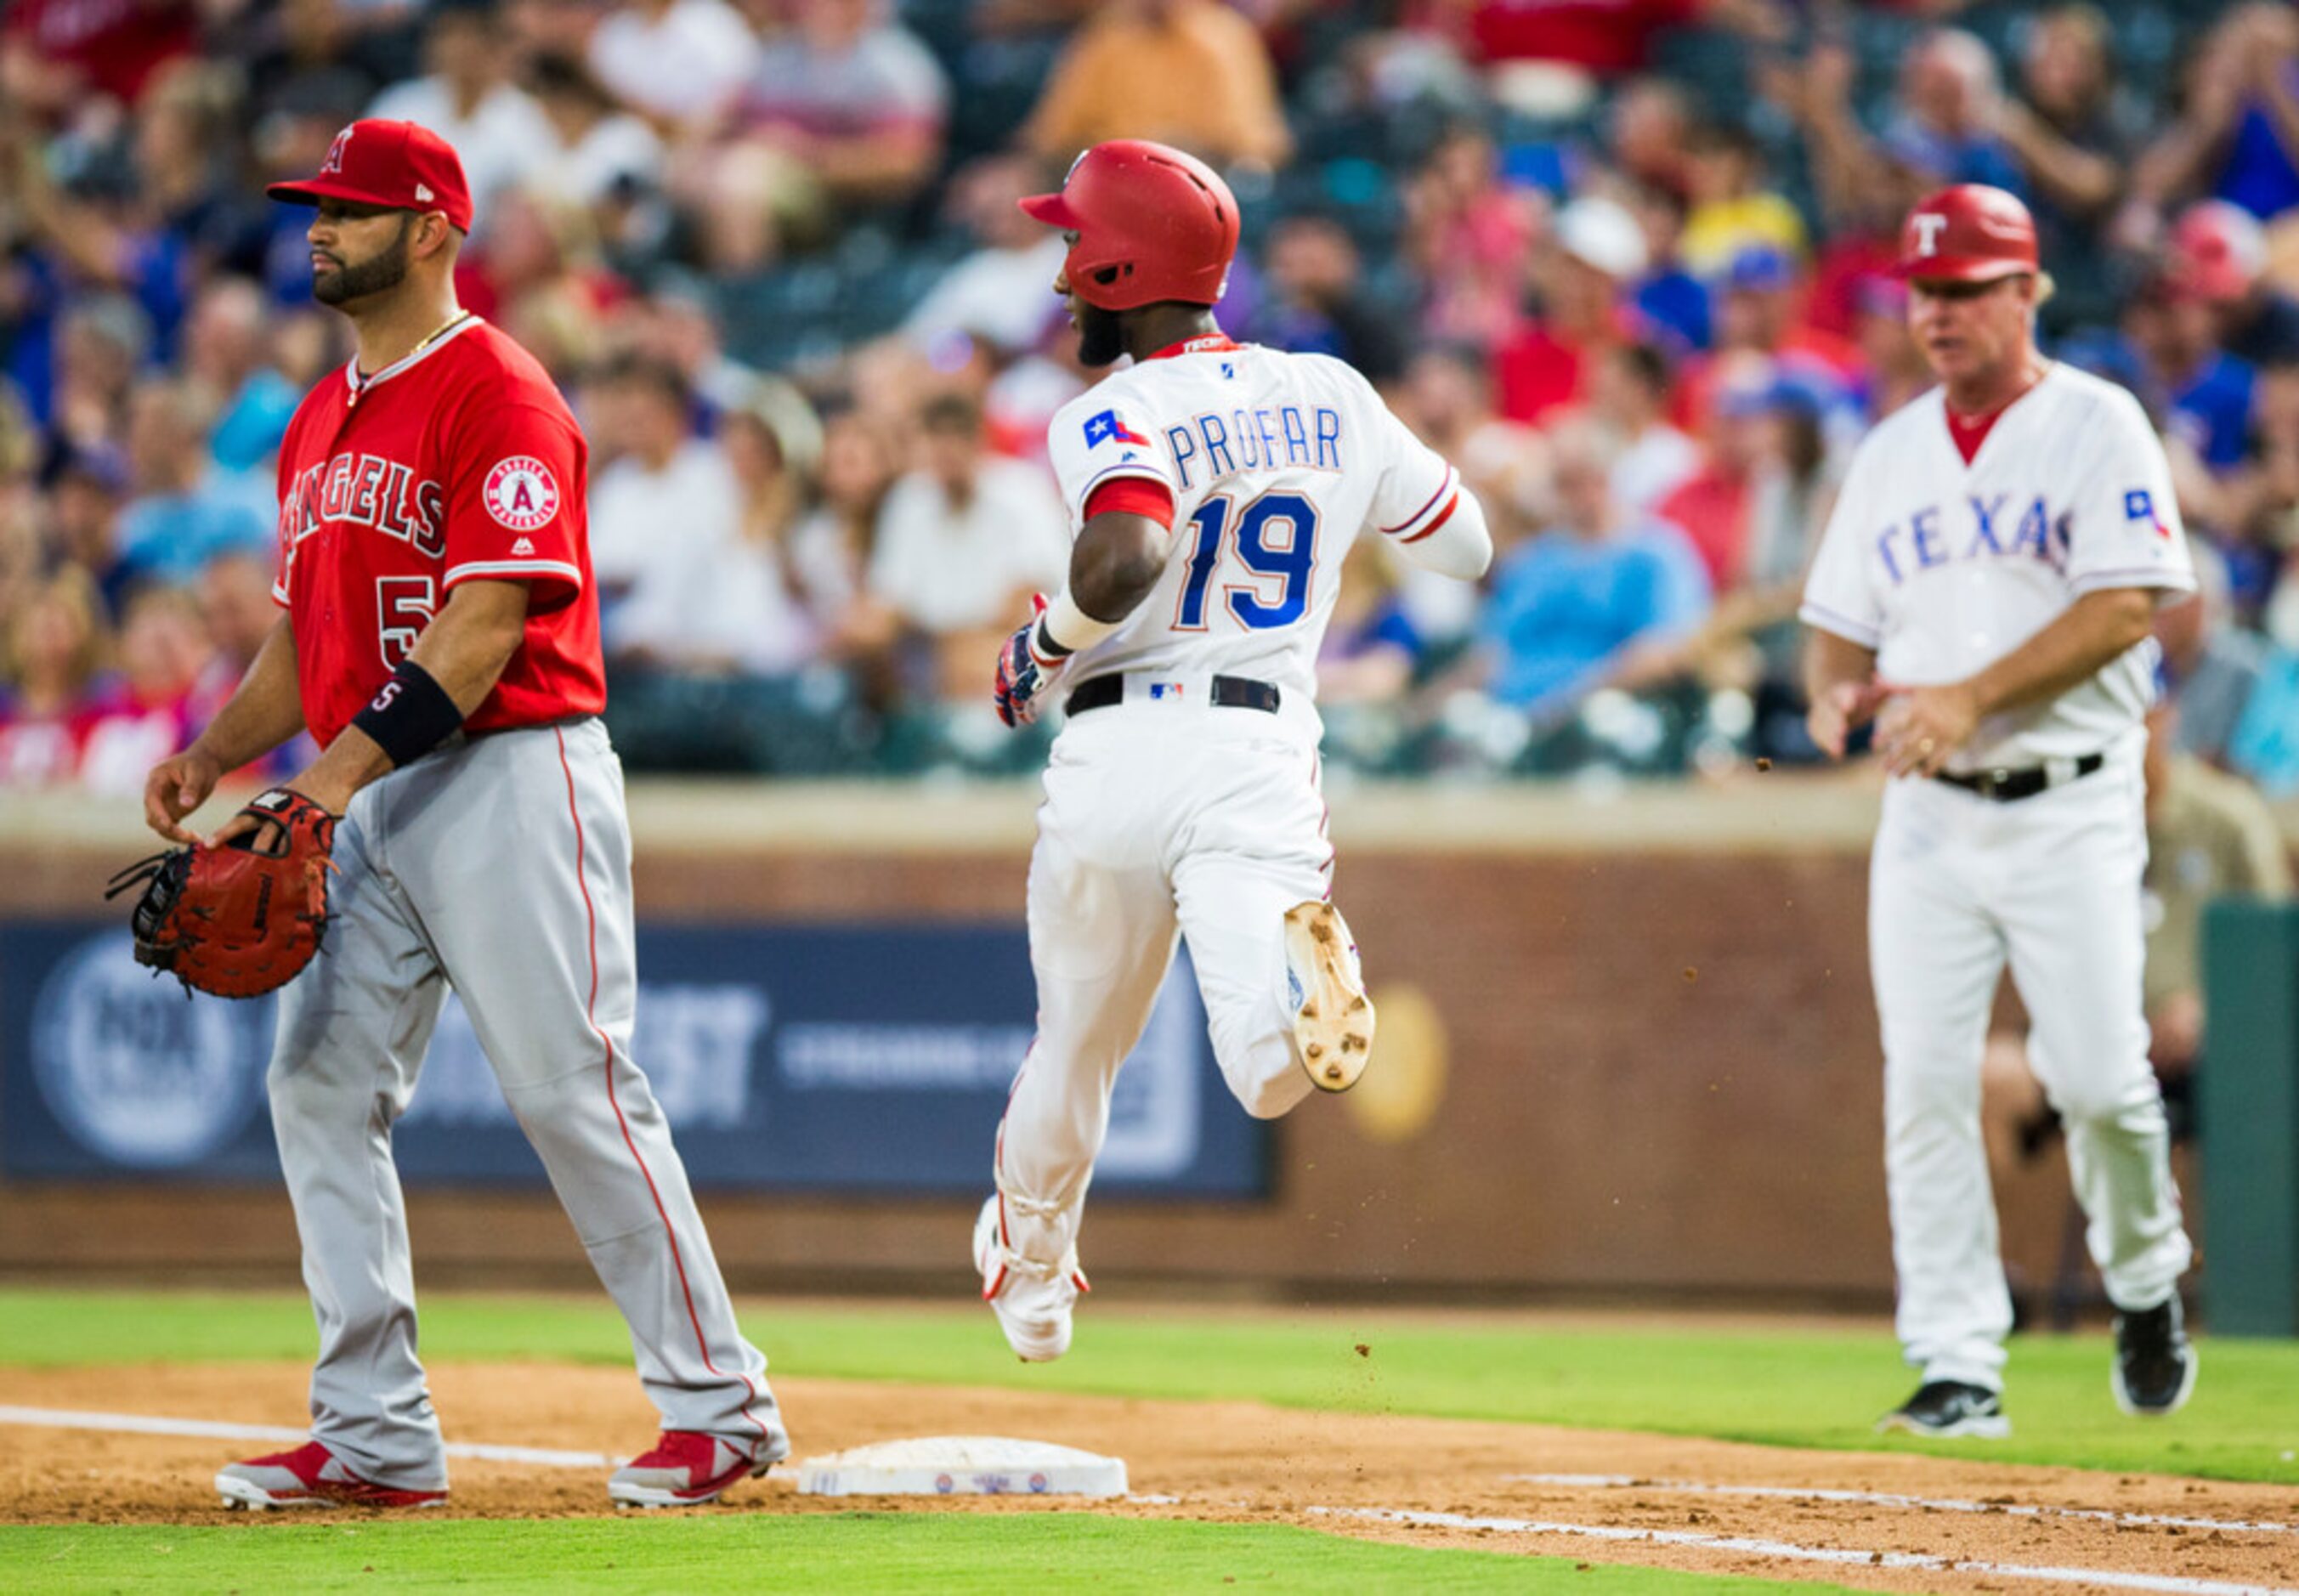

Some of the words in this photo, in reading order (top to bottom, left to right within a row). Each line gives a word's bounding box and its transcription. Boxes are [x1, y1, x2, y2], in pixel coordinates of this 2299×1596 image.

[320, 122, 355, 174] A
[1911, 213, 1948, 258] T
[1163, 404, 1343, 493] PROFAR
[280, 452, 445, 564] ANGELS
[512, 478, 535, 512] A
[1169, 489, 1322, 632] 19
[372, 682, 402, 712] 5
